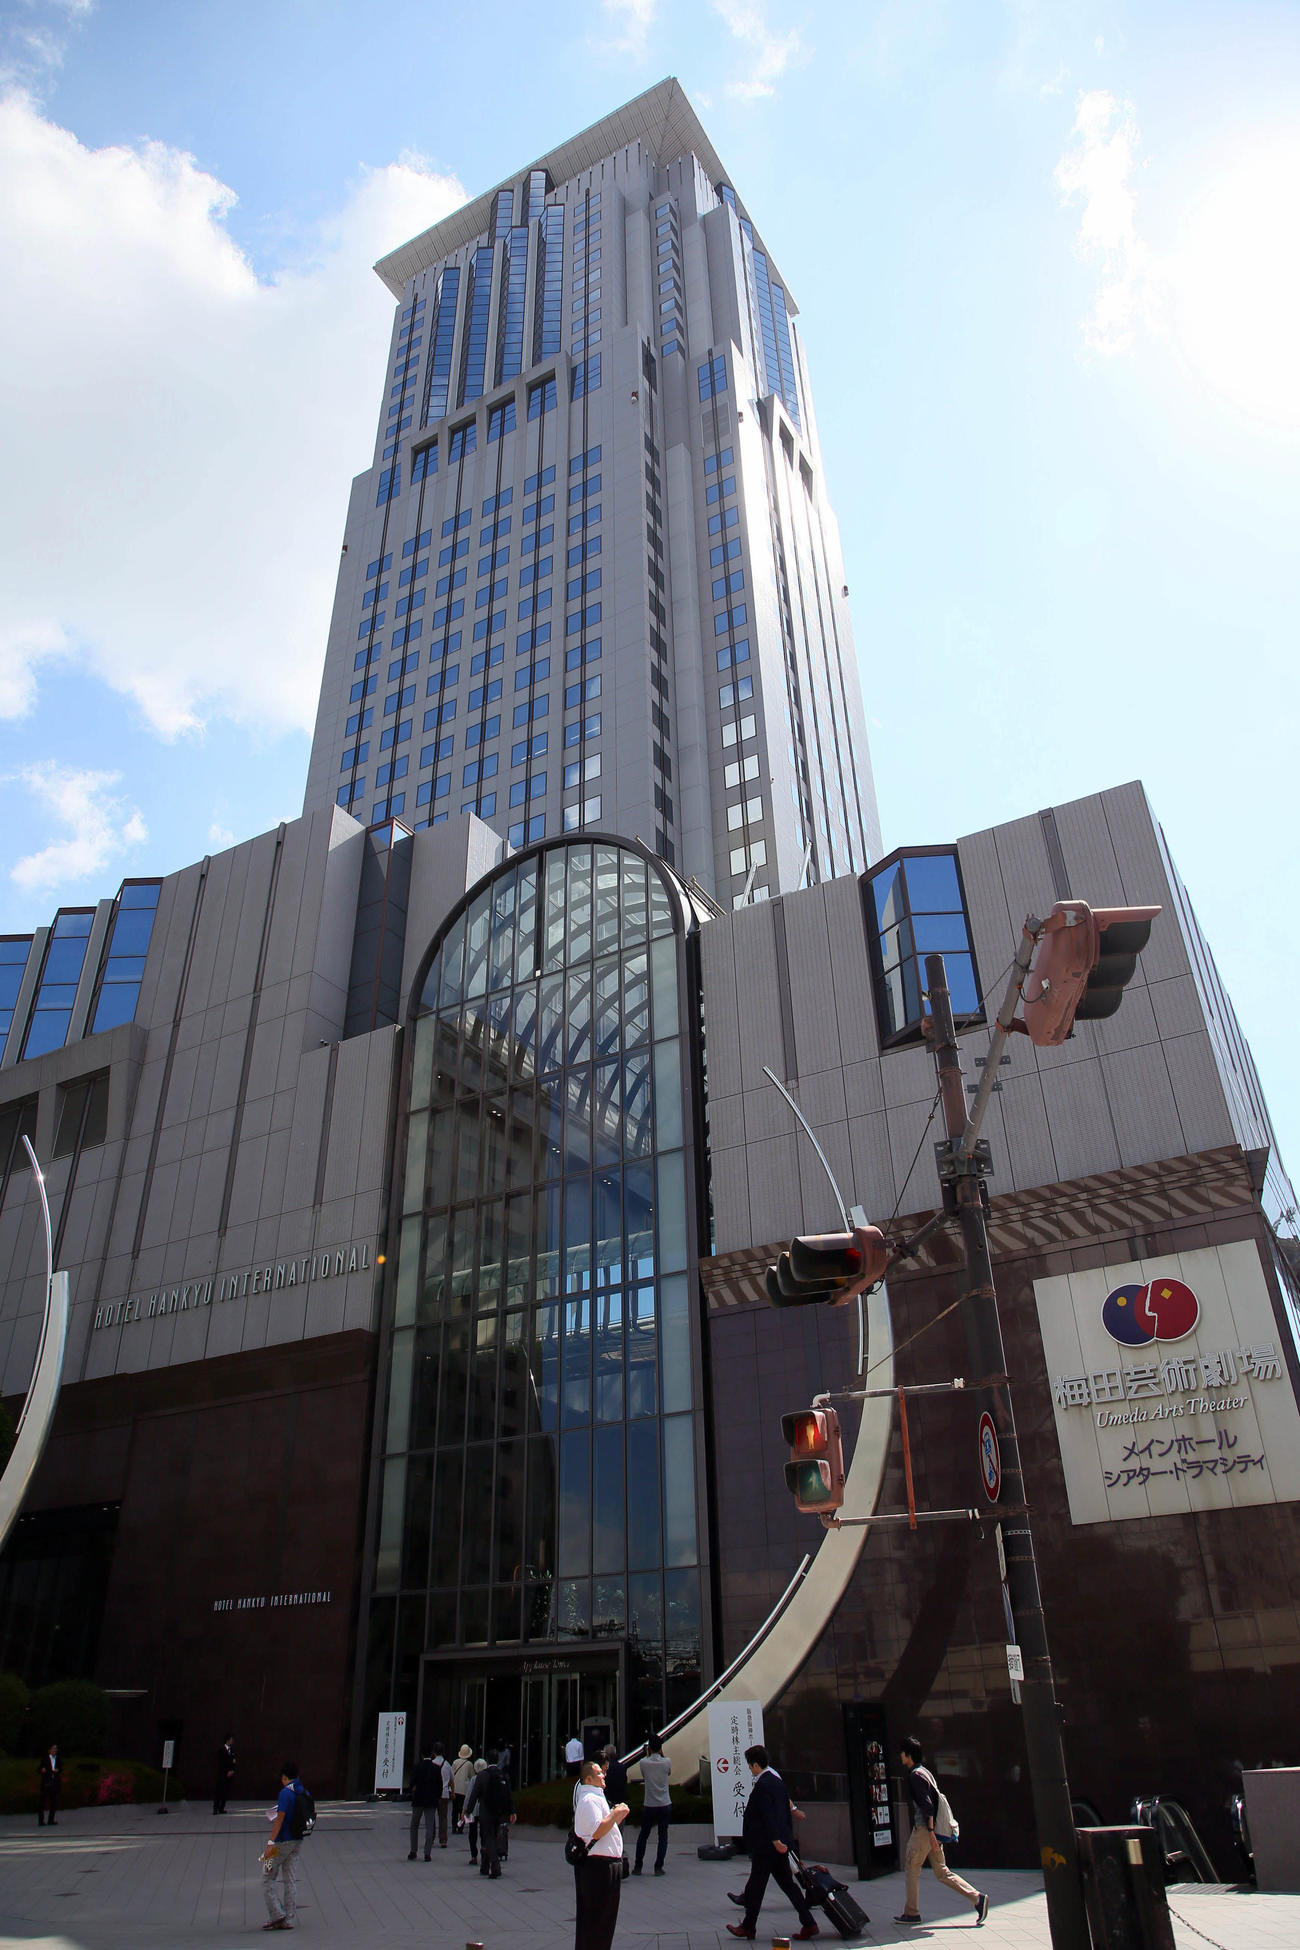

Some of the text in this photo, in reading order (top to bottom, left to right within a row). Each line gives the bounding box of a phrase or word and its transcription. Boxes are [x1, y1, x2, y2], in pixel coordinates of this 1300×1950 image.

[94, 1245, 369, 1329] HOTEL HANKYU INTERNATIONAL
[1053, 1342, 1282, 1409] 梅田芸術劇場
[1096, 1395, 1248, 1428] Umeda Arts Theater
[1122, 1429, 1238, 1462] メインホール
[1104, 1454, 1265, 1488] シアター・ドラマシティ
[213, 1600, 233, 1611] HOTEL
[270, 1592, 331, 1607] INTERNATIONAL
